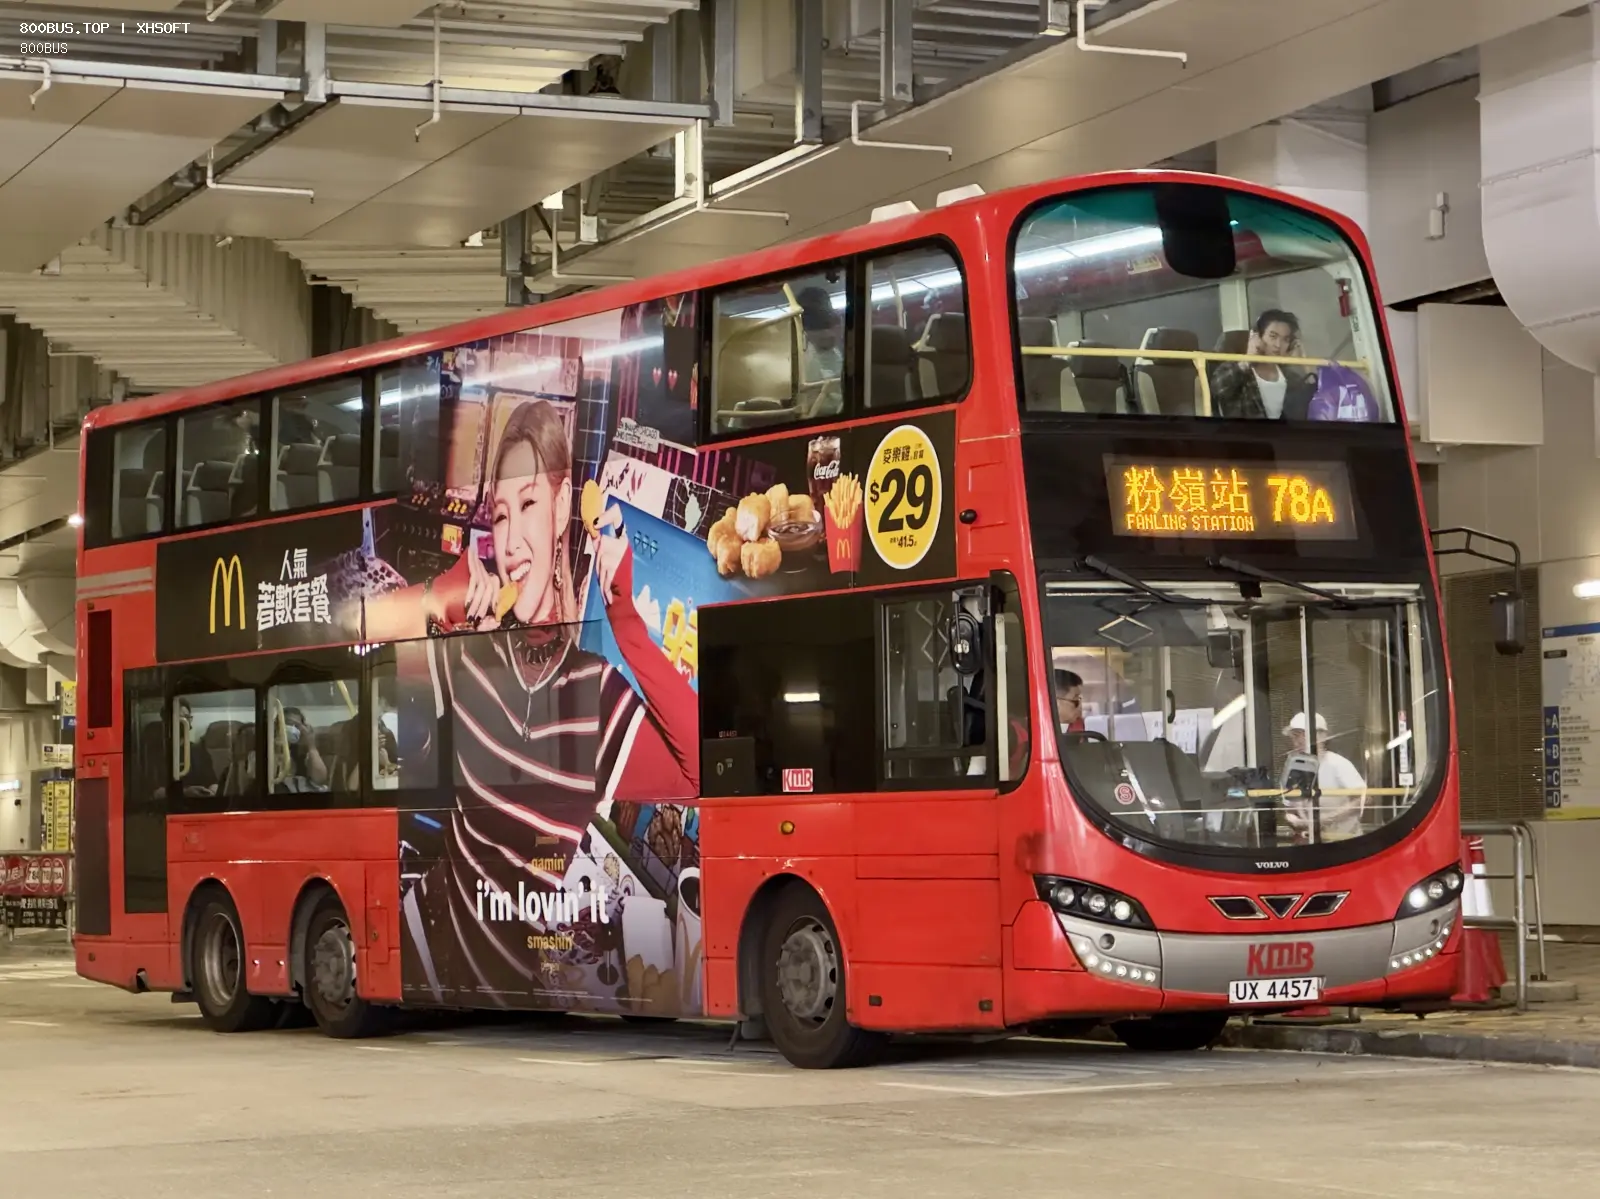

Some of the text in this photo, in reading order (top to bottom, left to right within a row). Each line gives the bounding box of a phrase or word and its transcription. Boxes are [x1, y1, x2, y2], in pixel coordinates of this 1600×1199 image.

[1124, 466, 1249, 514] 粉嶺站
[1267, 475, 1334, 523] 78A
[1127, 513, 1254, 532] FANLING STATION
[280, 548, 308, 581] 人氣
[1551, 714, 1559, 728] A
[1552, 744, 1559, 759] B
[782, 768, 813, 792] KMB
[1552, 770, 1559, 785] C
[1553, 792, 1560, 807] D
[1255, 861, 1290, 869] VOLVO
[476, 879, 610, 924] i'm lovin' it
[1246, 941, 1315, 977] KMB
[1235, 979, 1313, 1001] UX 4457
